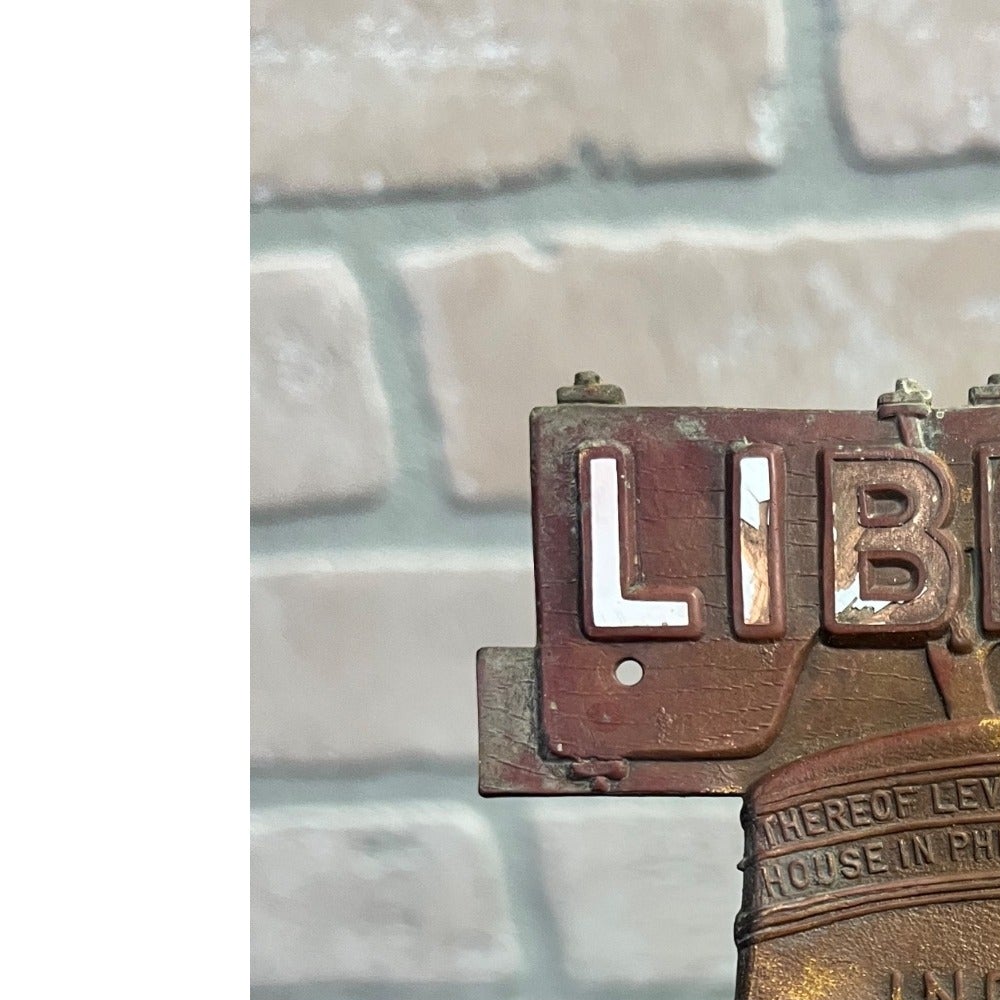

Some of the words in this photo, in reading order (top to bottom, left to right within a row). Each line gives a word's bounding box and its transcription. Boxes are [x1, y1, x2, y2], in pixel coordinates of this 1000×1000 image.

[763, 784, 922, 845] THEREOF
[761, 841, 887, 898] HOUSE
[898, 833, 934, 869] IN
